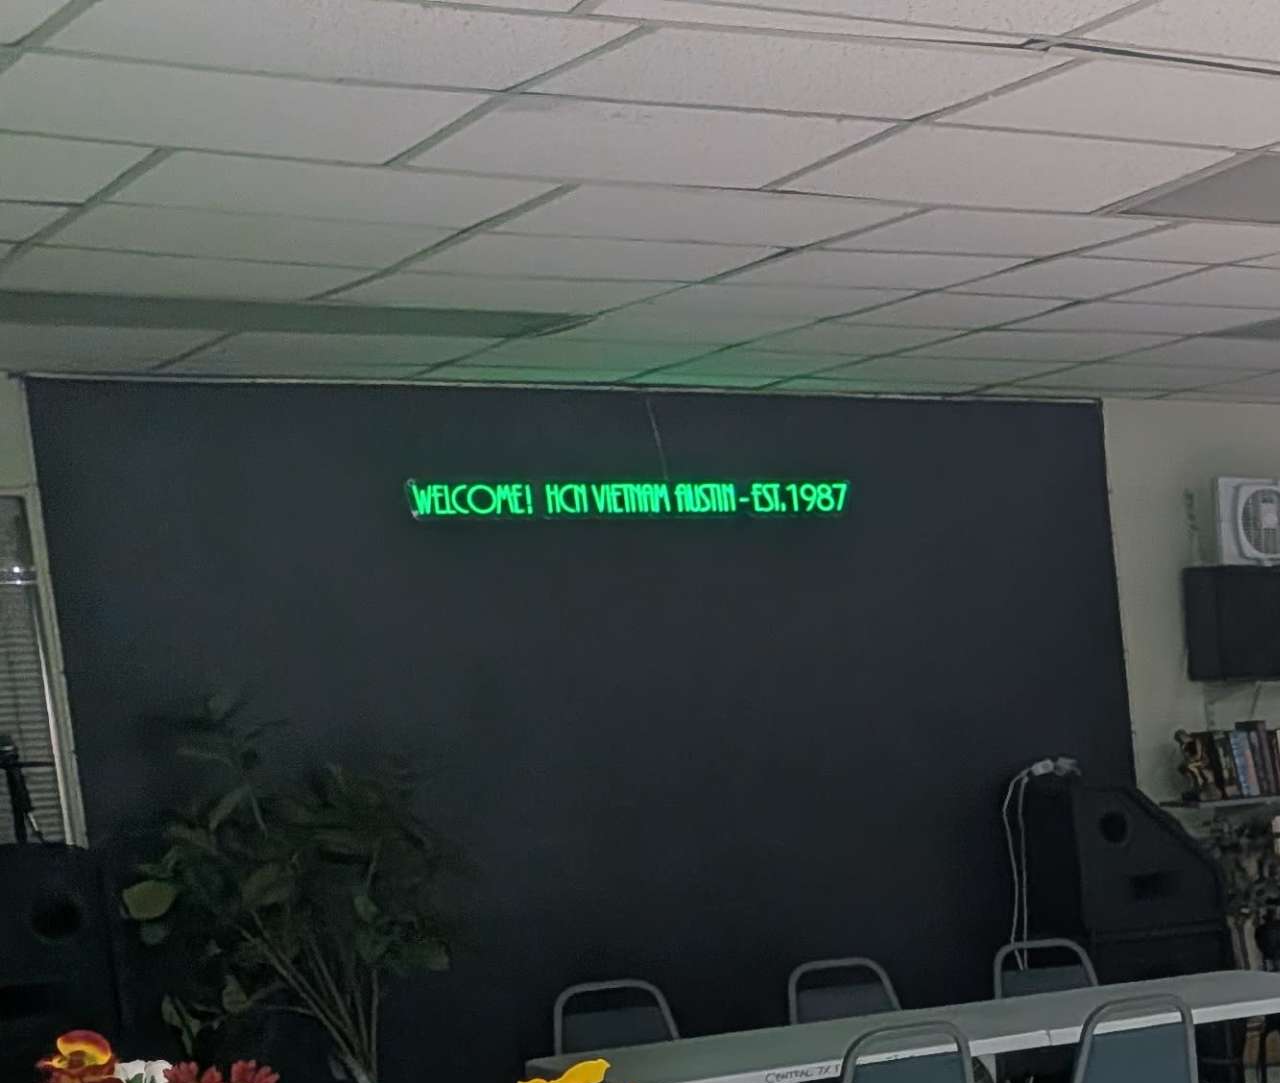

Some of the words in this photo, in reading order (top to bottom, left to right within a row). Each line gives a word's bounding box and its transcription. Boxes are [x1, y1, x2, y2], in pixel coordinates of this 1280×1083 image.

[412, 484, 533, 515] WELCOME!
[545, 484, 588, 513] HCN
[591, 484, 671, 513] VIETNAM
[674, 483, 736, 513] AUSTIN
